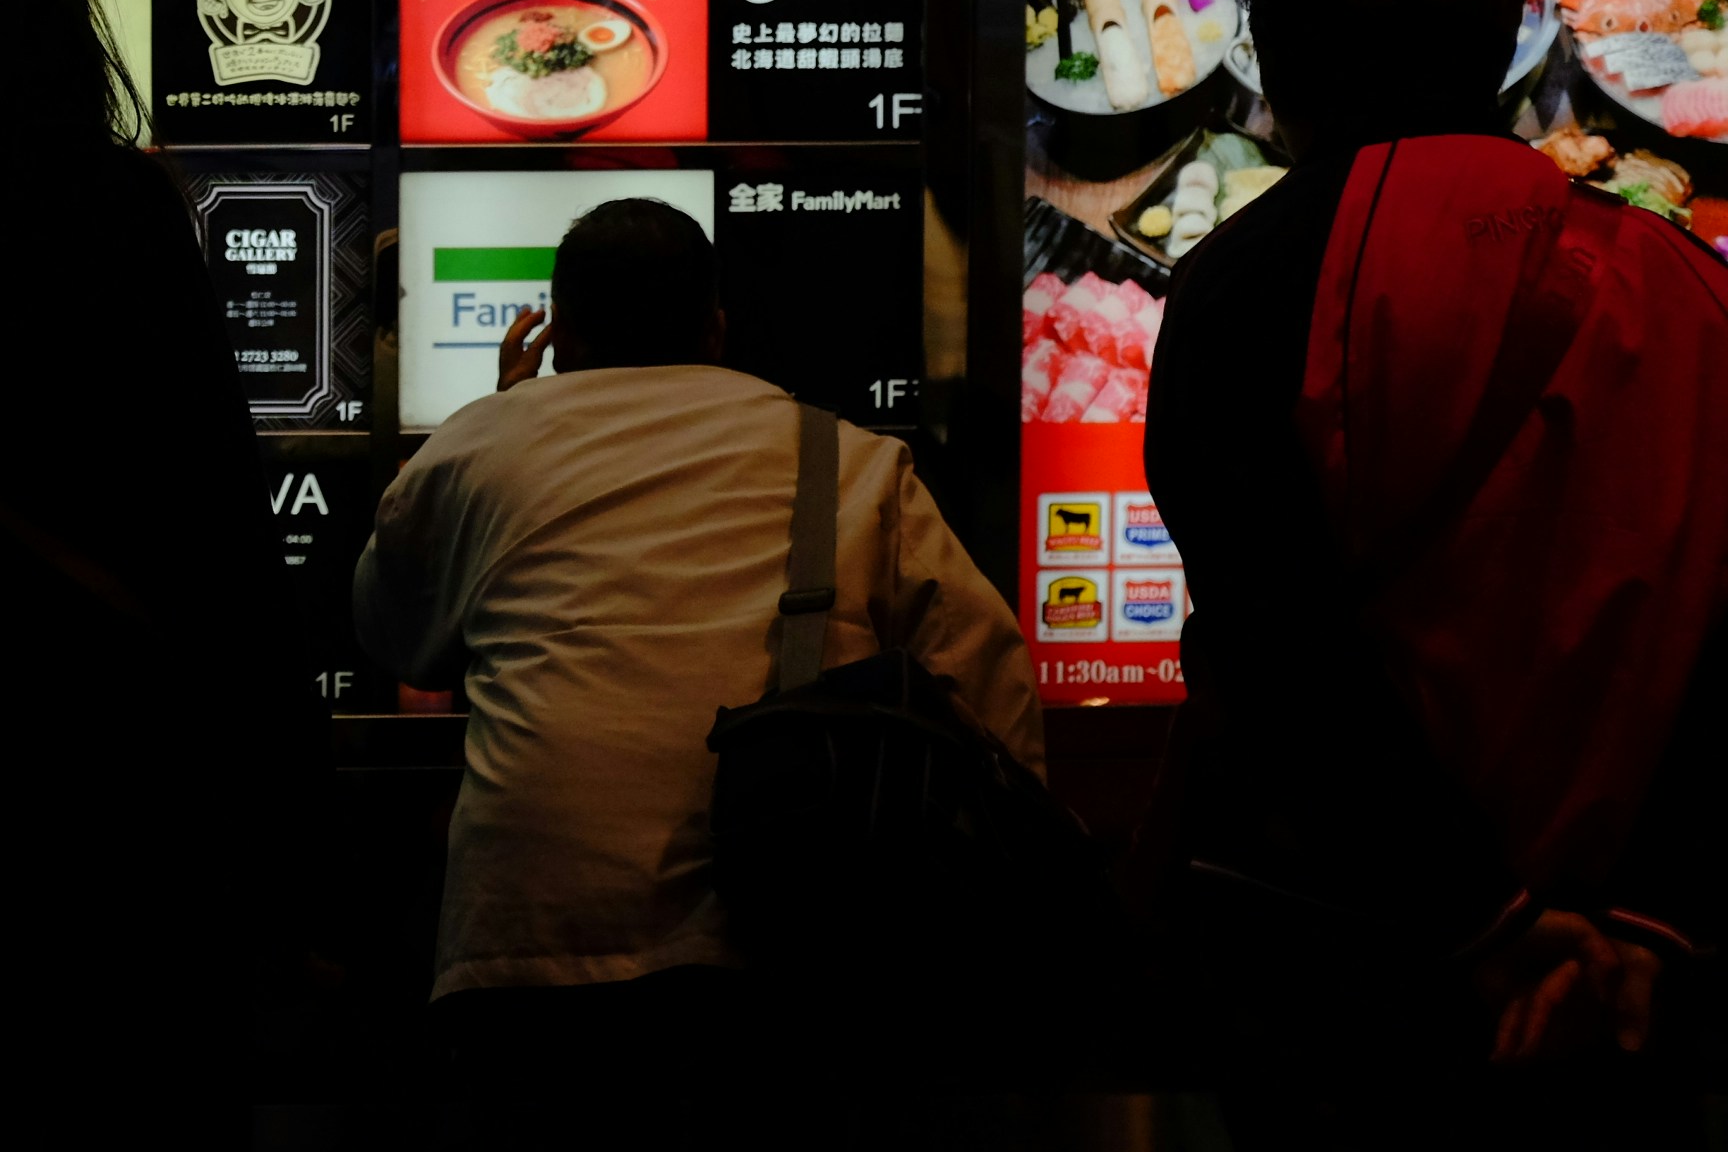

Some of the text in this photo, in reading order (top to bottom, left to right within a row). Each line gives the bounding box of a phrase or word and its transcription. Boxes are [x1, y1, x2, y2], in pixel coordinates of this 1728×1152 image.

[868, 93, 918, 129] 1F
[329, 114, 356, 133] 1F
[728, 182, 902, 213] 全家 FamilyMart
[225, 229, 298, 248] CIGAR
[224, 248, 299, 262] GALLERY
[240, 350, 270, 363] 2723
[869, 379, 909, 408] 1F
[335, 401, 365, 422] 1F
[1127, 585, 1170, 599] USDA
[1124, 604, 1172, 619] CHOICE
[314, 671, 355, 699] 1F
